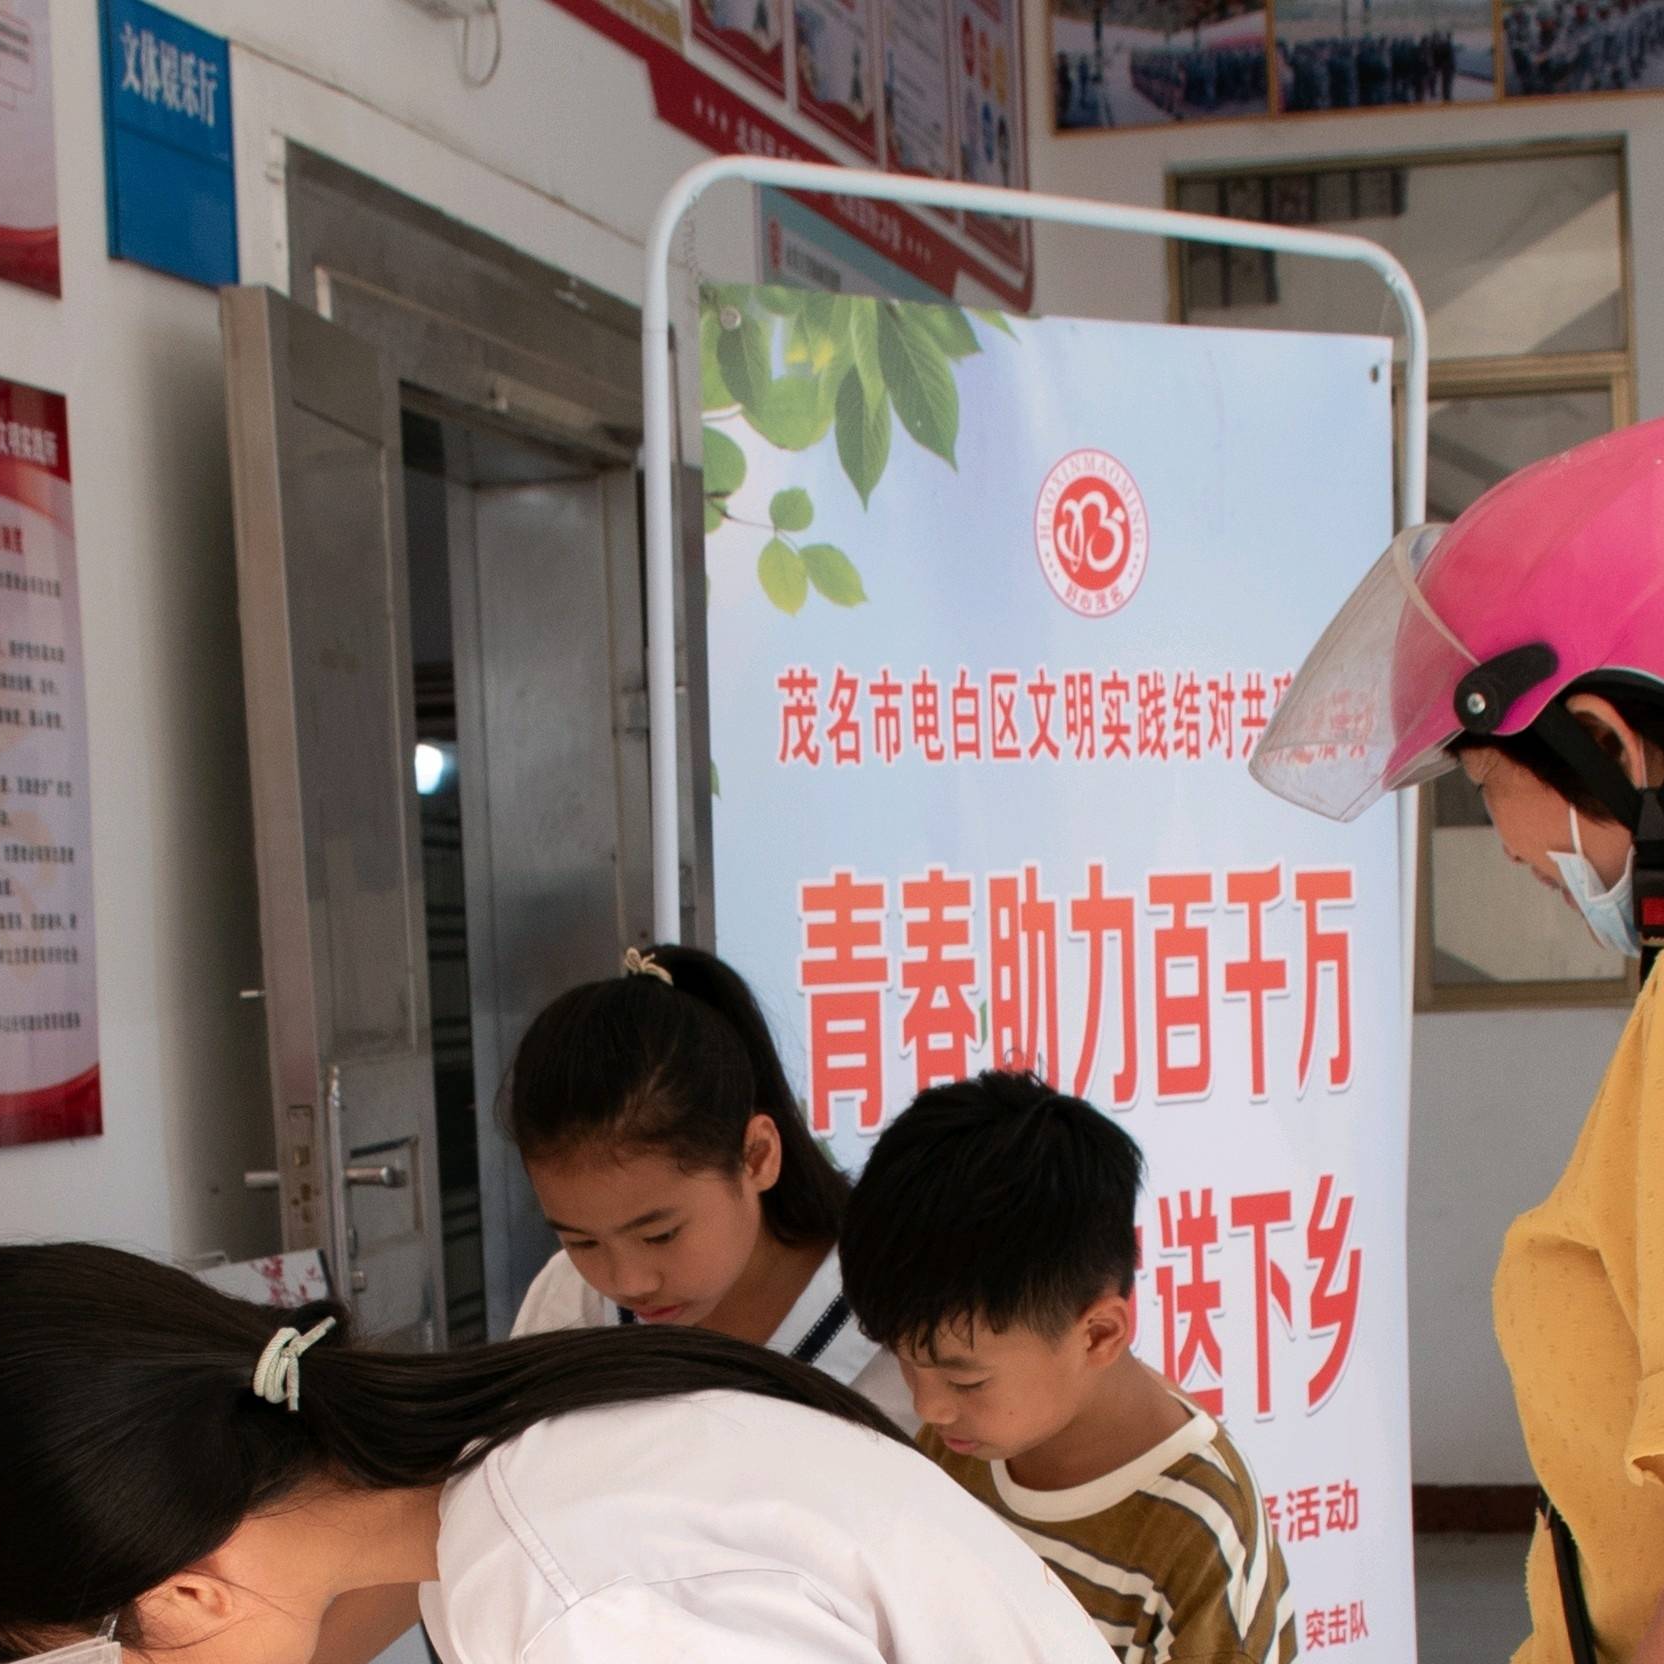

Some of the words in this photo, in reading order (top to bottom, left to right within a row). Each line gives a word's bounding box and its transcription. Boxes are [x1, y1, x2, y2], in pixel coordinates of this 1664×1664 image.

[799, 862, 1354, 1133] 青春助力百千万
[1131, 1173, 1362, 1418] 送下乡
[1305, 1600, 1369, 1651] 突击队
